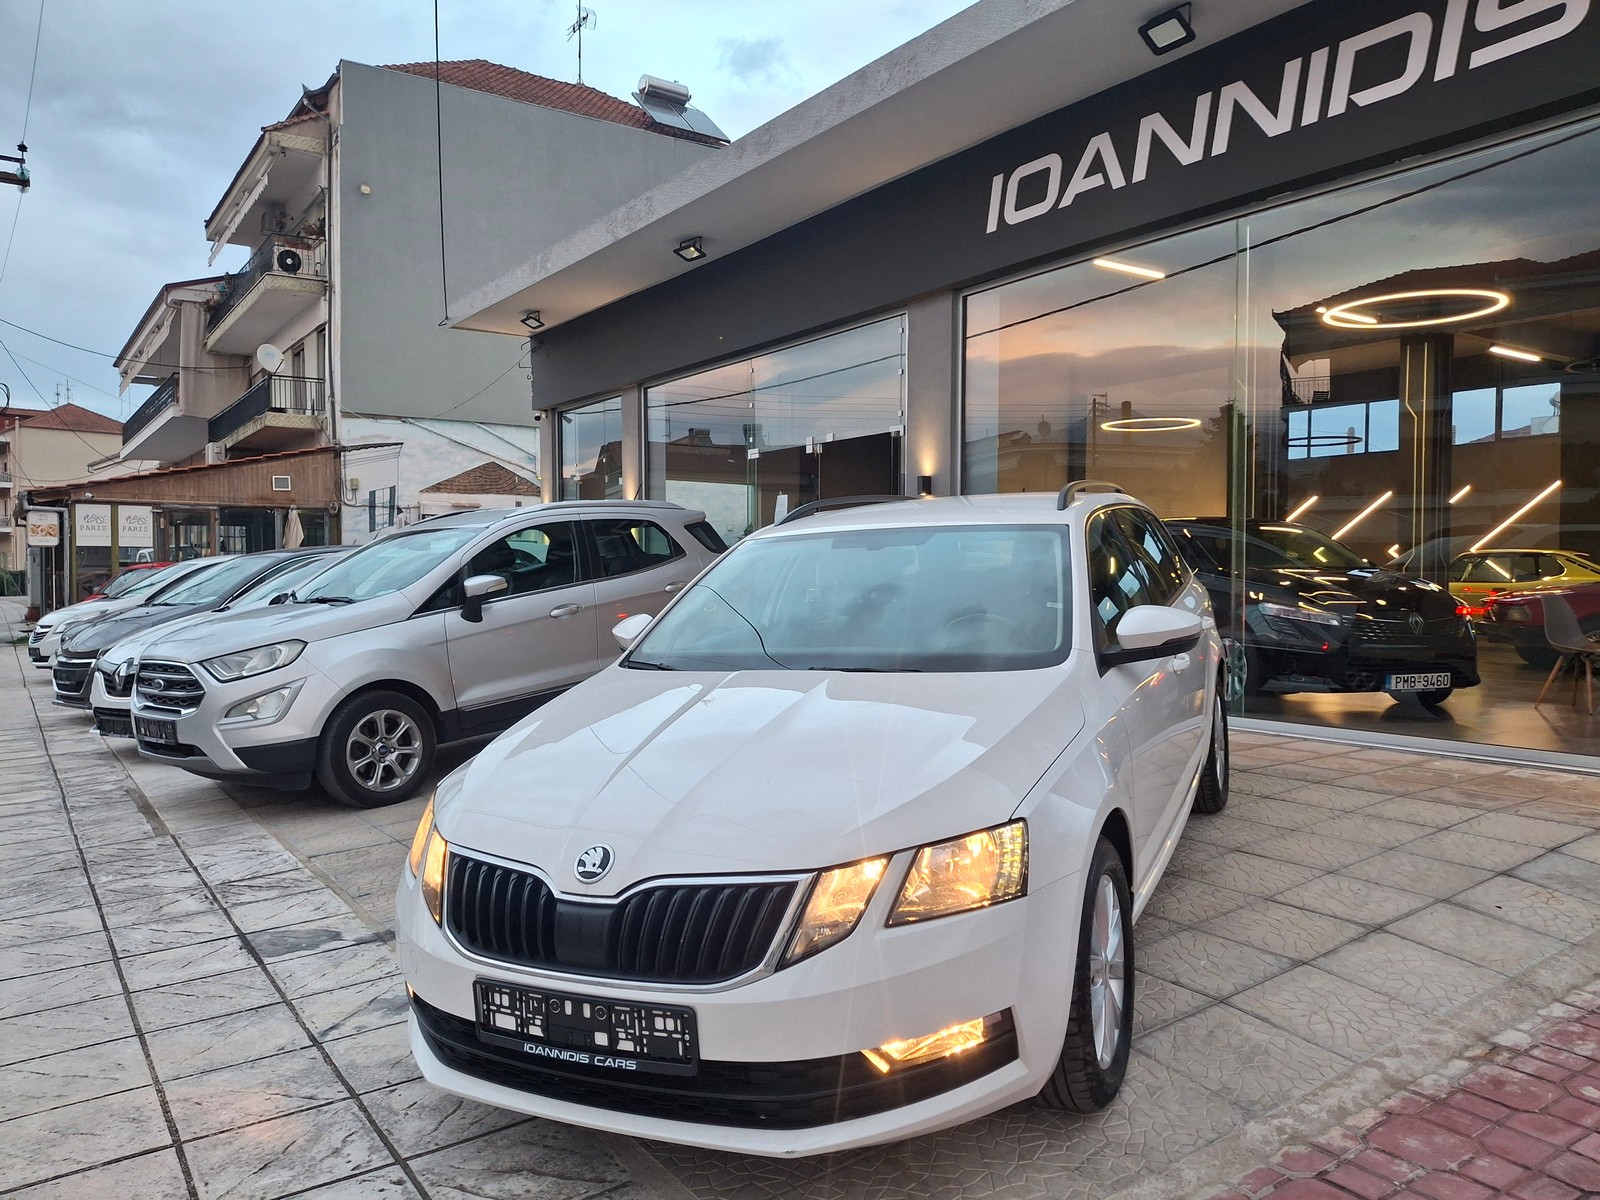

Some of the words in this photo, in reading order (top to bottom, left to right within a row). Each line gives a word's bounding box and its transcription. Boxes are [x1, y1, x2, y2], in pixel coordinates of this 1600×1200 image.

[986, 0, 1591, 234] IOANNIDIS
[80, 524, 107, 532] PARIS
[122, 525, 149, 533] PARIS
[523, 1043, 590, 1064] IOANNIDIS
[594, 1056, 637, 1070] CARS
